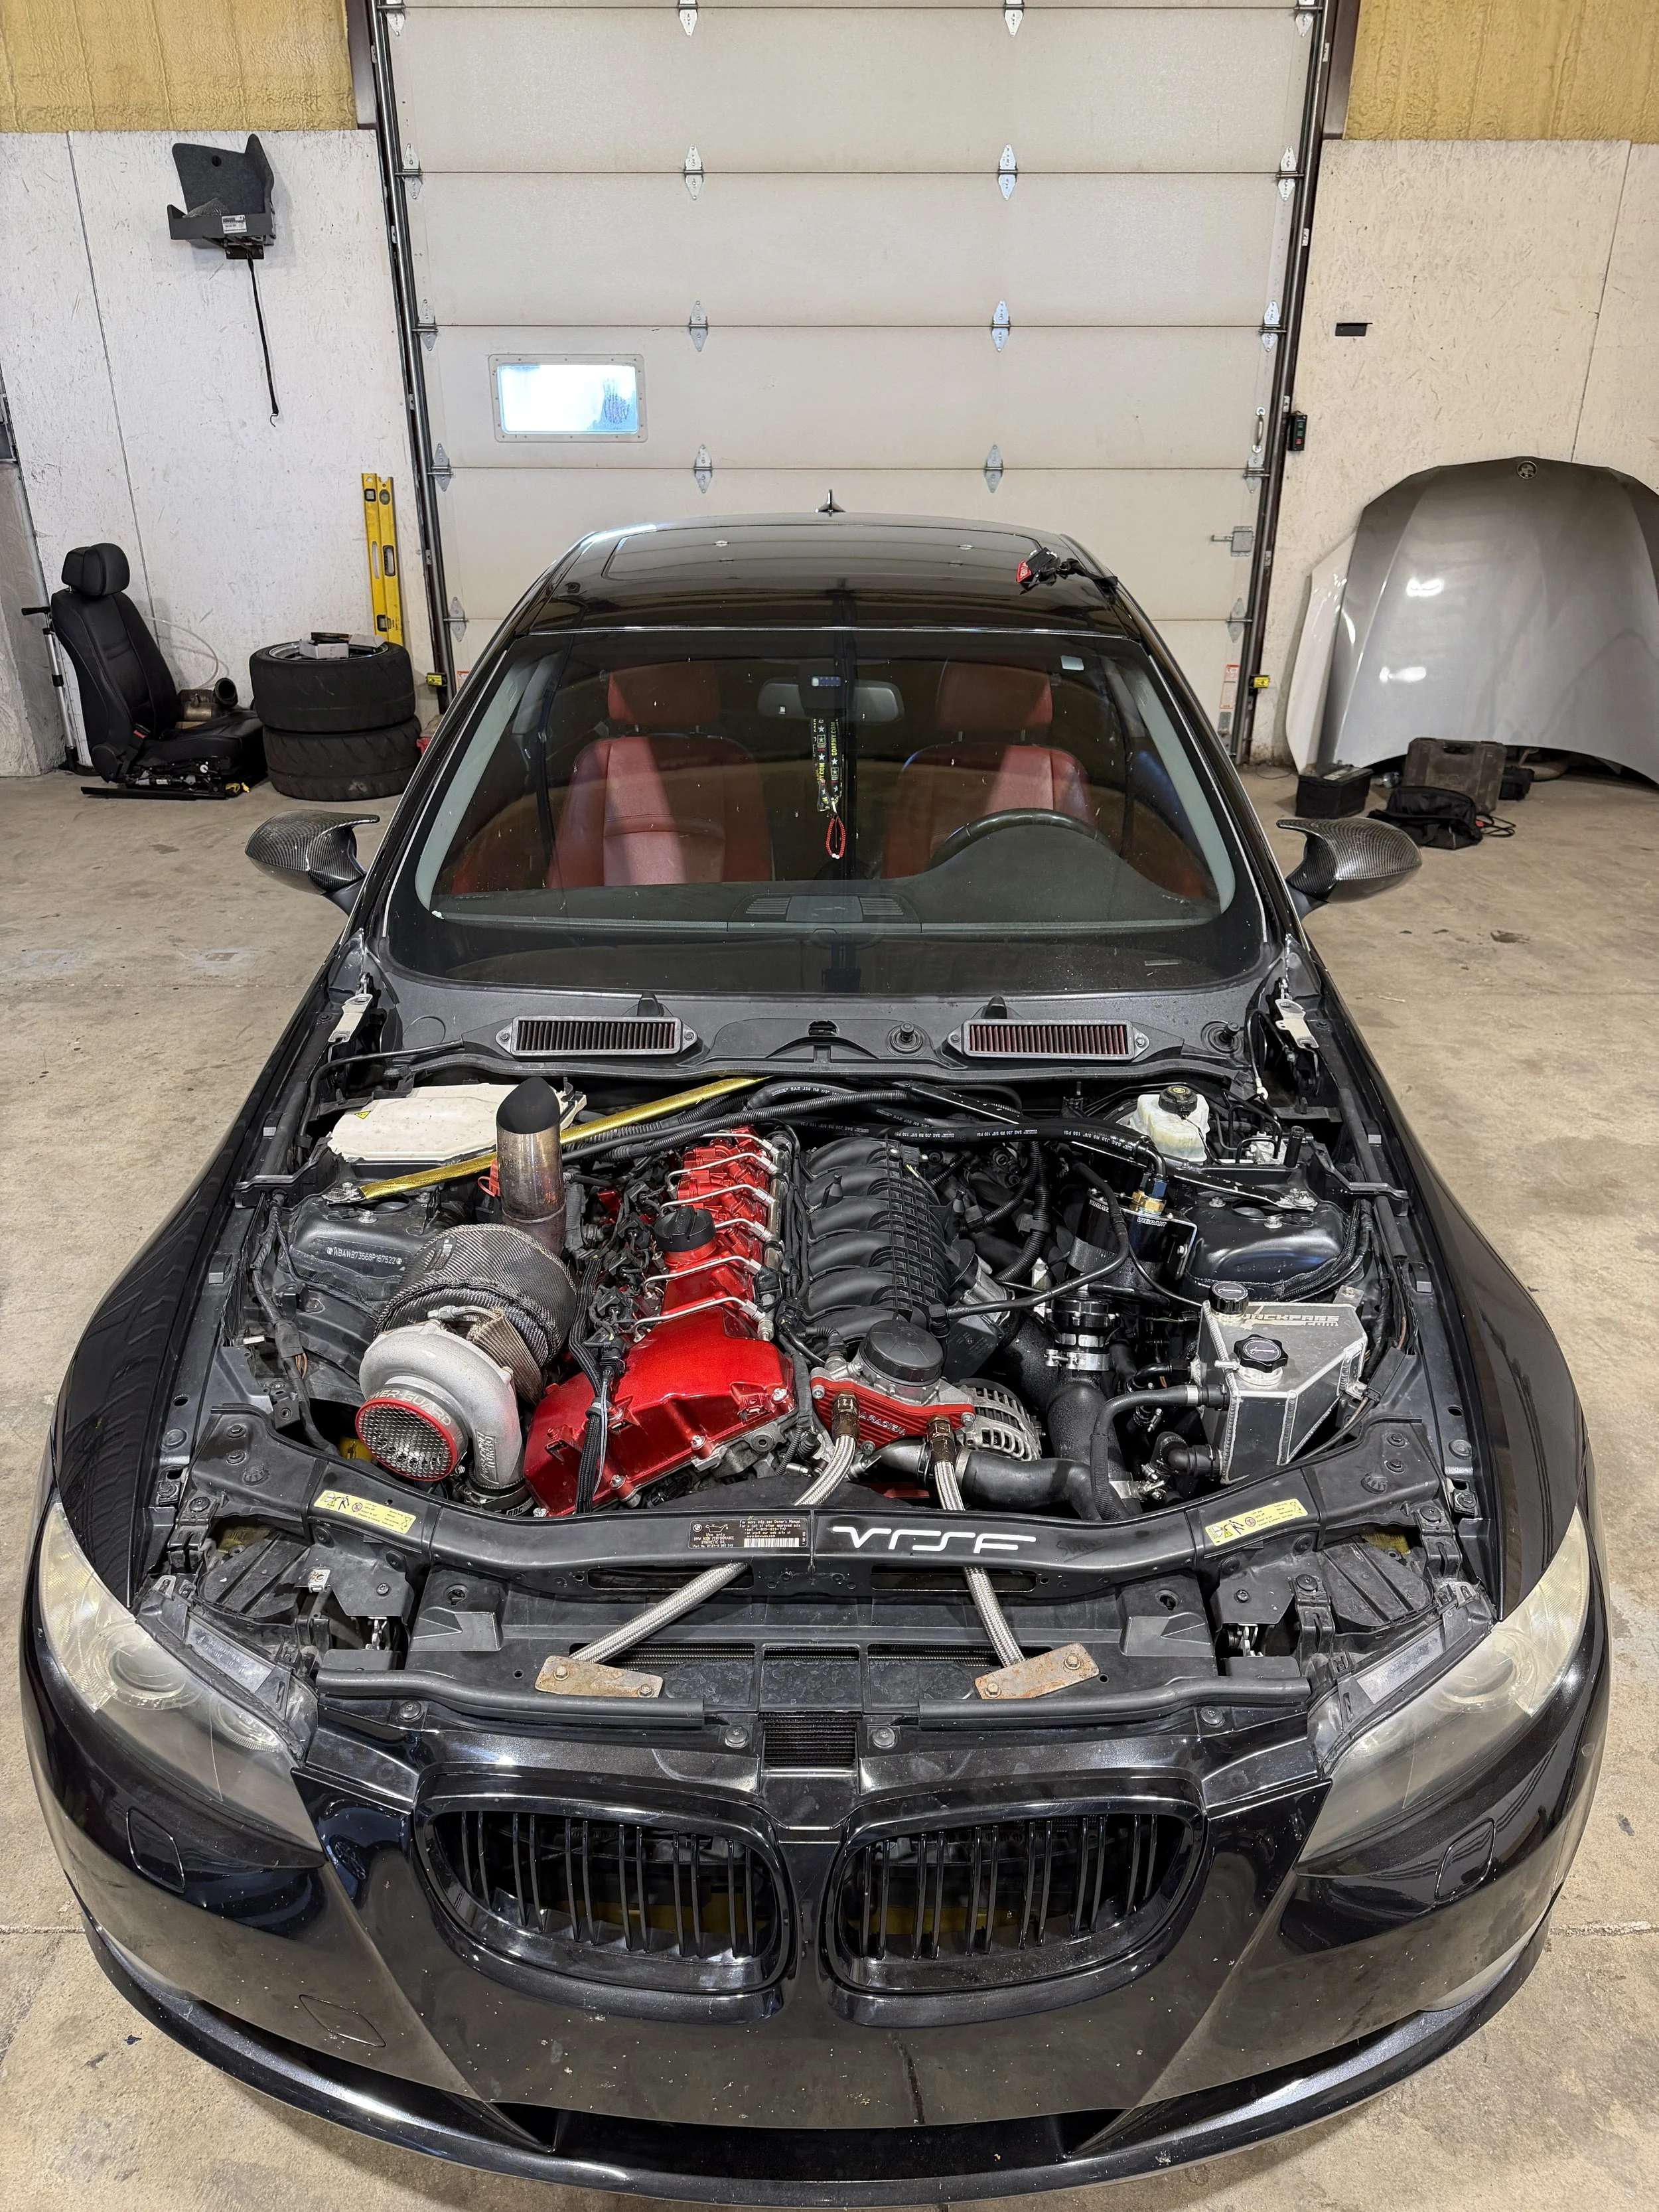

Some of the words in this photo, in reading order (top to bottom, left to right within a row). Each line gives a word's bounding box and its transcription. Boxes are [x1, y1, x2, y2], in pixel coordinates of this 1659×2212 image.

[1137, 1217, 1167, 1227] VIBRANT
[859, 1411, 906, 1436] ARADIGM
[484, 1436, 496, 1468] TURBO
